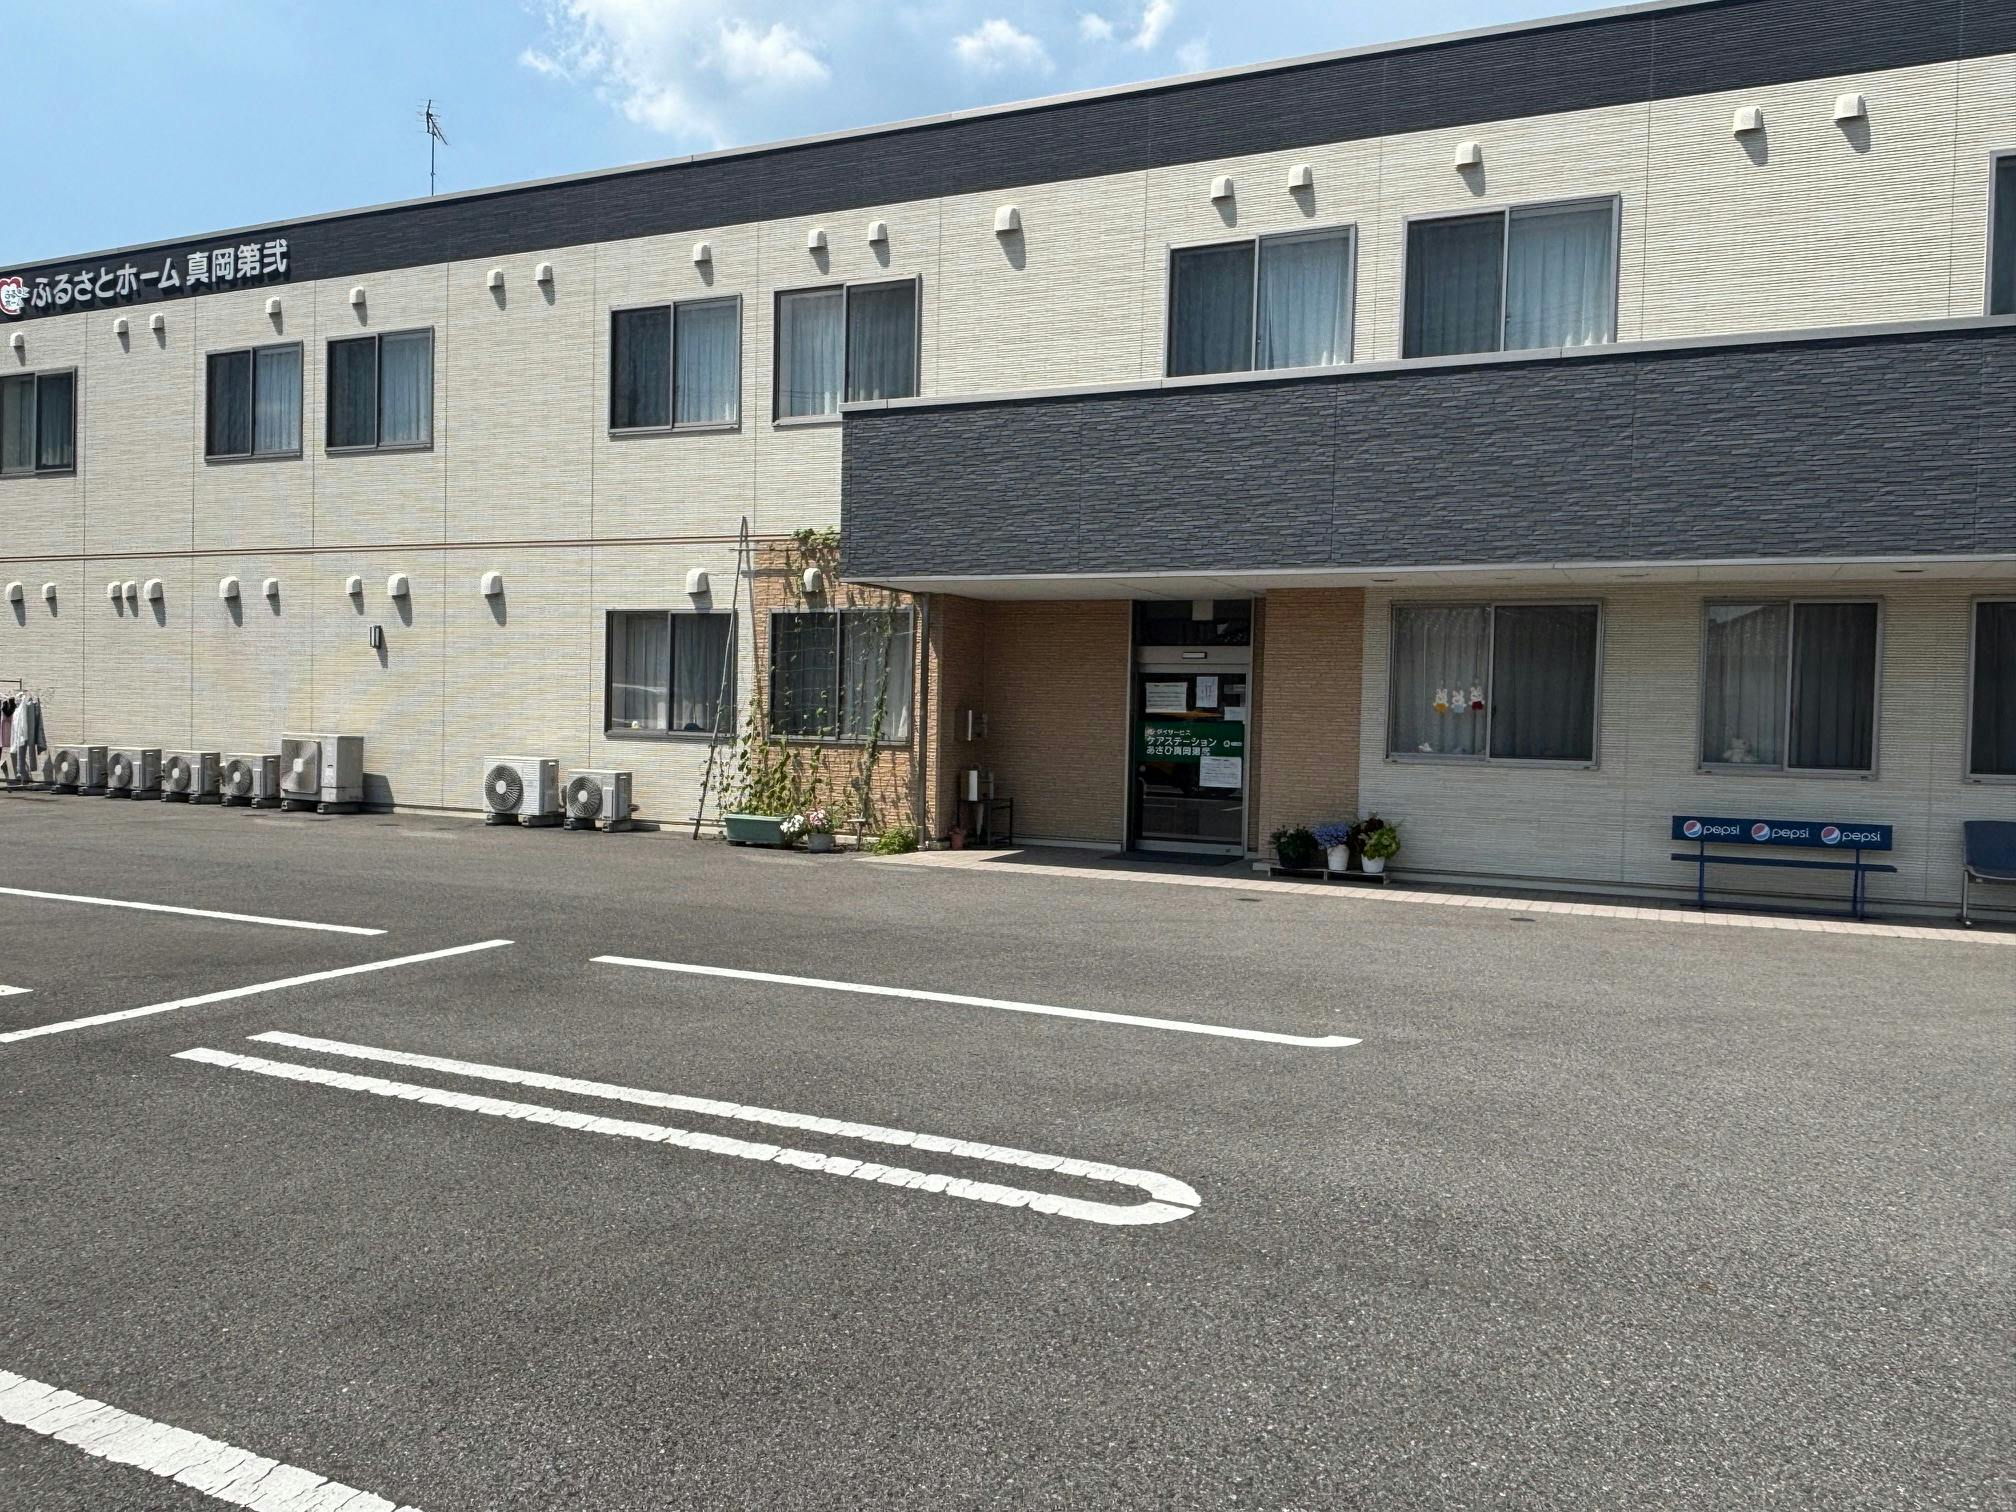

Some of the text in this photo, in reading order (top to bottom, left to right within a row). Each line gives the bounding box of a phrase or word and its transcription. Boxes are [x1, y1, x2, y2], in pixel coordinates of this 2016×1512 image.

[31, 257, 180, 306] ふるさとホーム
[1146, 736, 1217, 746] ケアステーション
[1703, 824, 1881, 843] pepsi pepsi pepsi
